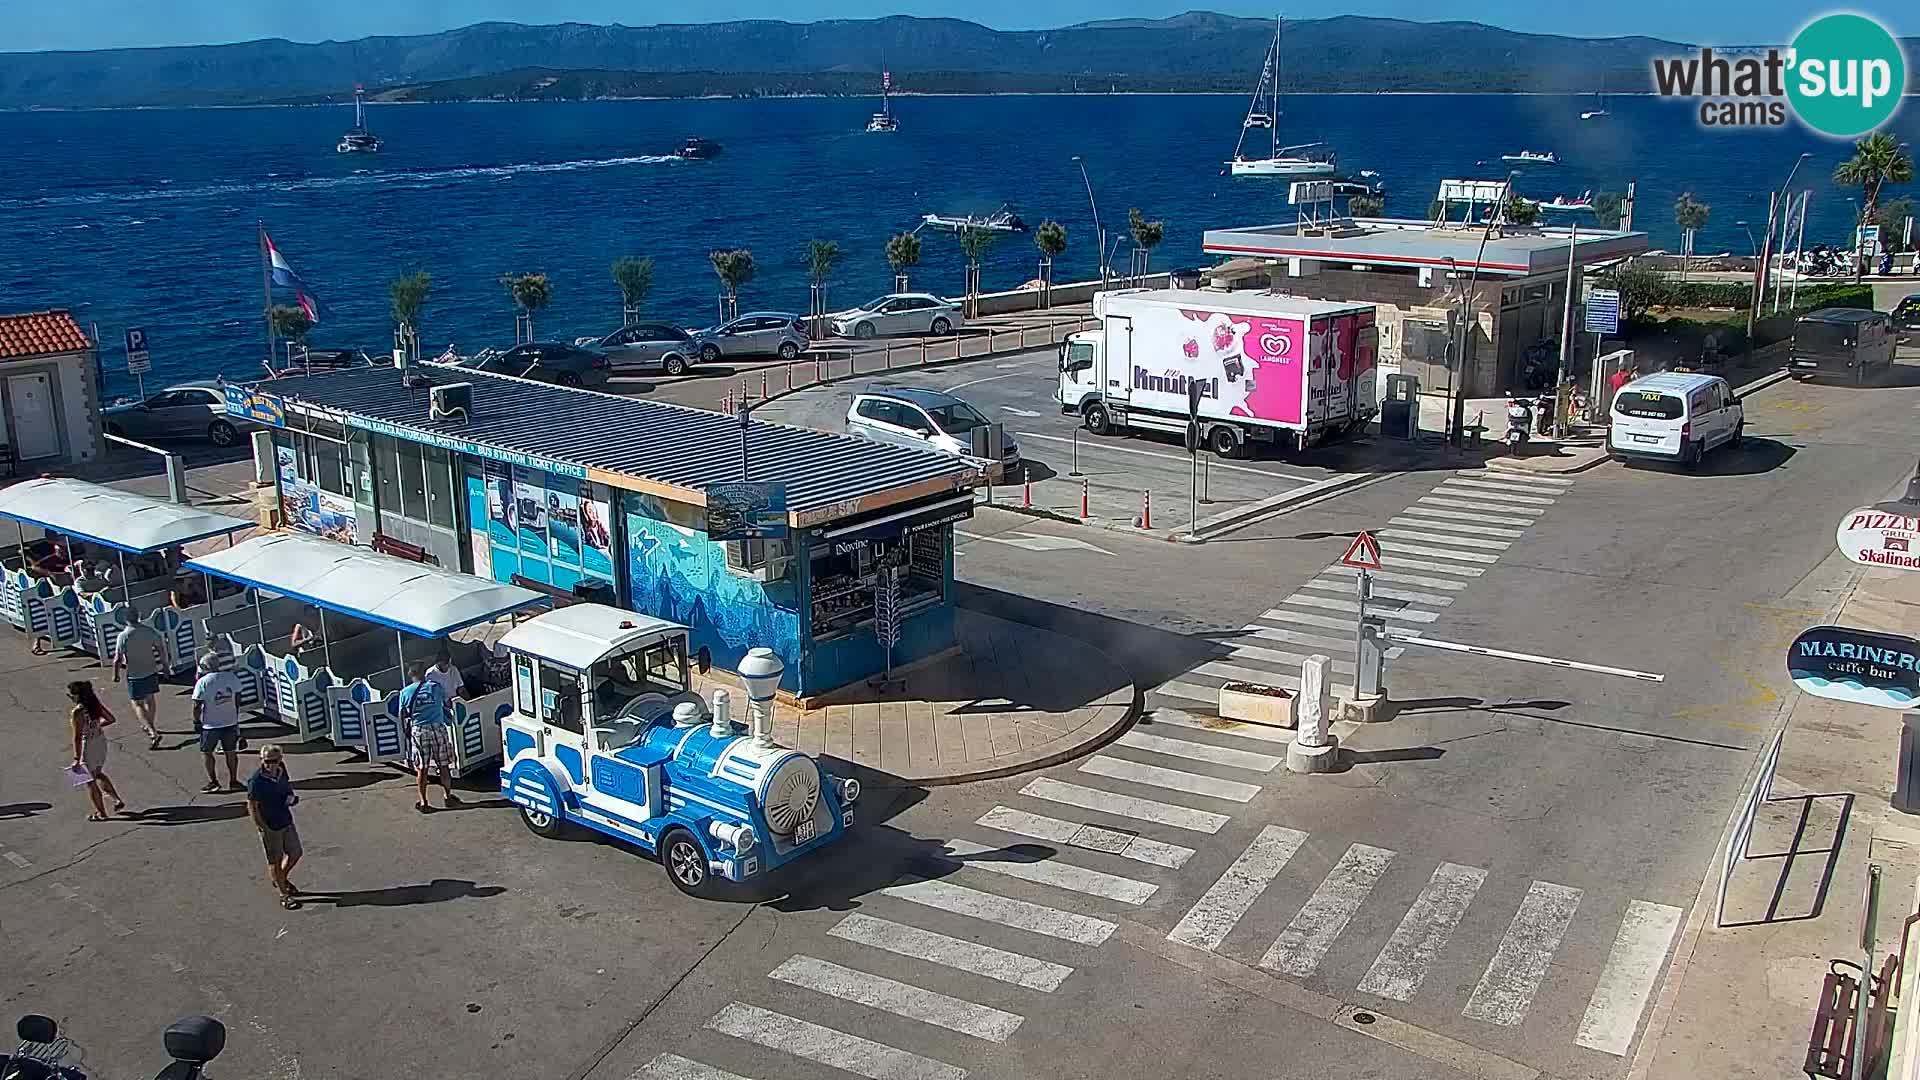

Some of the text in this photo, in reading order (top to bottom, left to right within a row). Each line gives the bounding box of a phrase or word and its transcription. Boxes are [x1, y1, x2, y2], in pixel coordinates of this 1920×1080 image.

[130, 331, 142, 349] P
[1640, 392, 1661, 401] TAXI
[435, 436, 468, 452] POSTAJA
[478, 444, 493, 457] BUS
[493, 448, 526, 465] STATION
[528, 456, 554, 470] TICKET
[555, 463, 583, 477] OFFICE
[1847, 514, 1920, 533] PIZZE
[1881, 529, 1916, 539] GRILL
[1828, 661, 1896, 679] caffe bar
